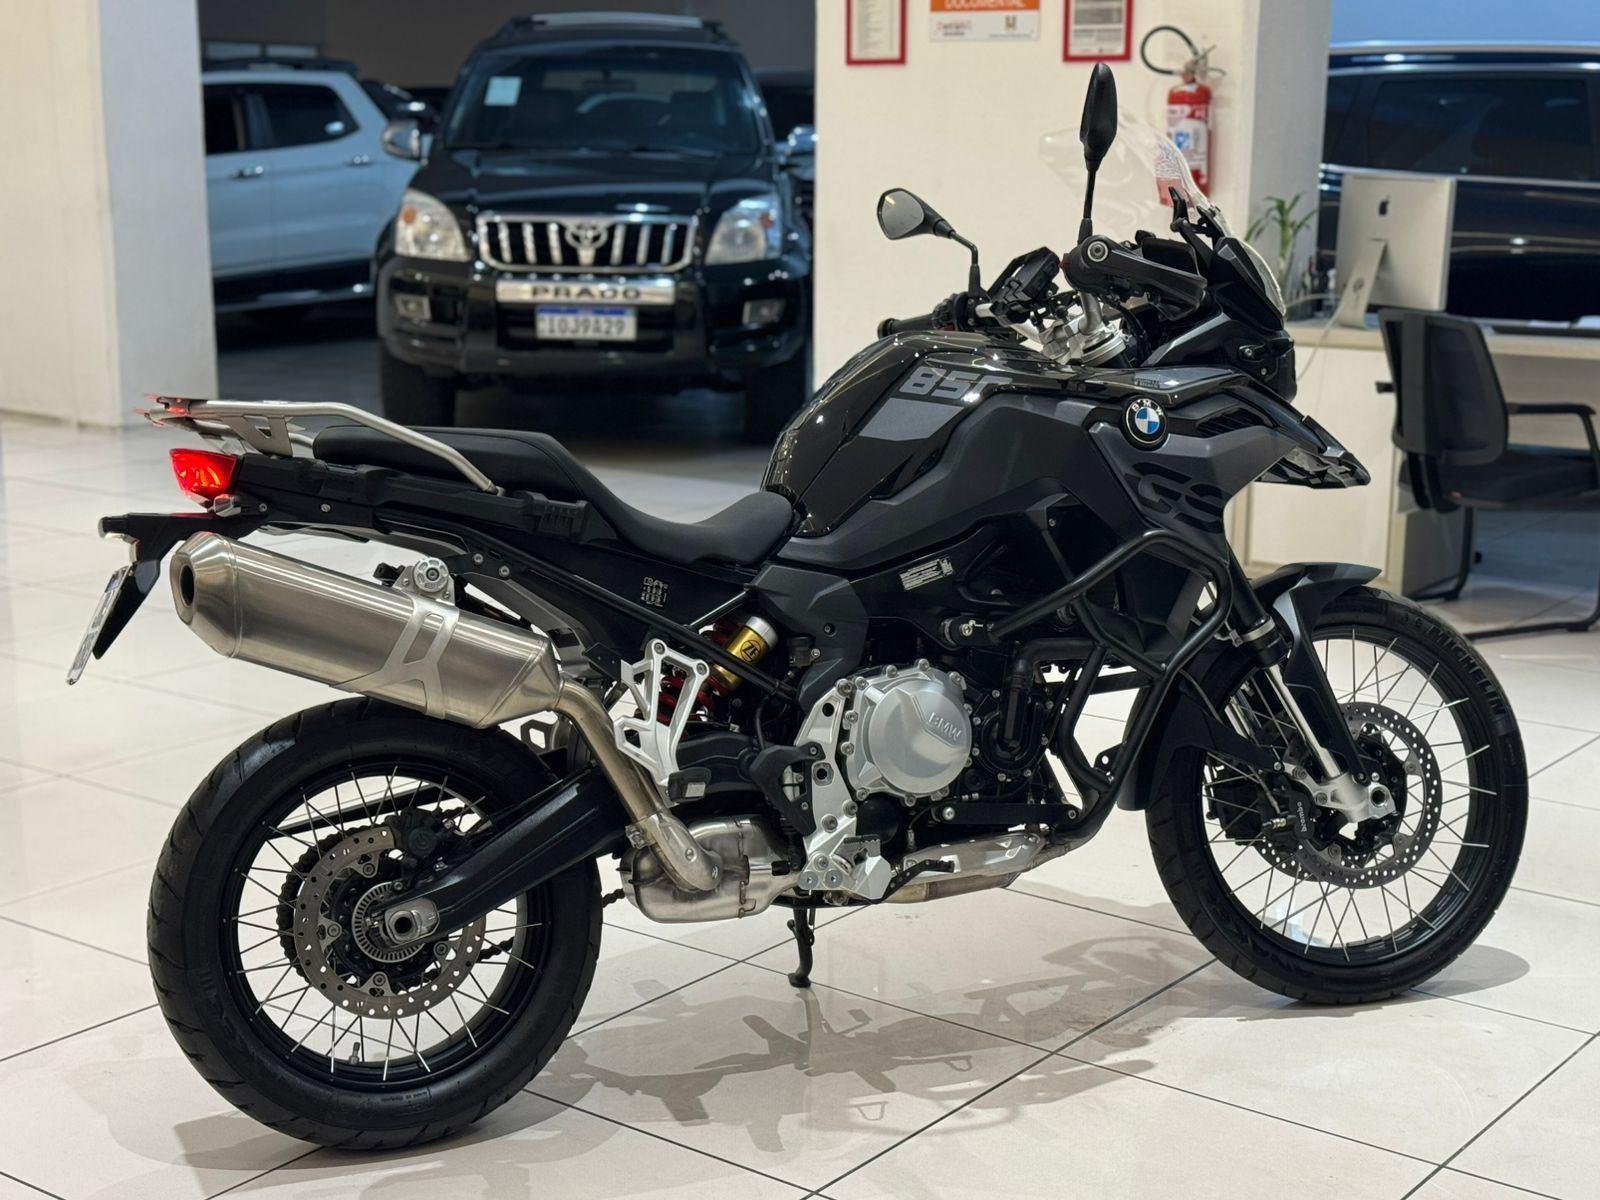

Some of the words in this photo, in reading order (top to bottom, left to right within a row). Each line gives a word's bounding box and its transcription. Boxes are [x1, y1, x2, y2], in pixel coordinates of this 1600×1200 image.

[531, 286, 641, 299] PRADO
[1131, 398, 1165, 417] BMW
[742, 640, 762, 660] ZF
[1425, 624, 1508, 716] MICHELIN
[929, 711, 962, 741] BMW
[1297, 800, 1309, 833] brembo
